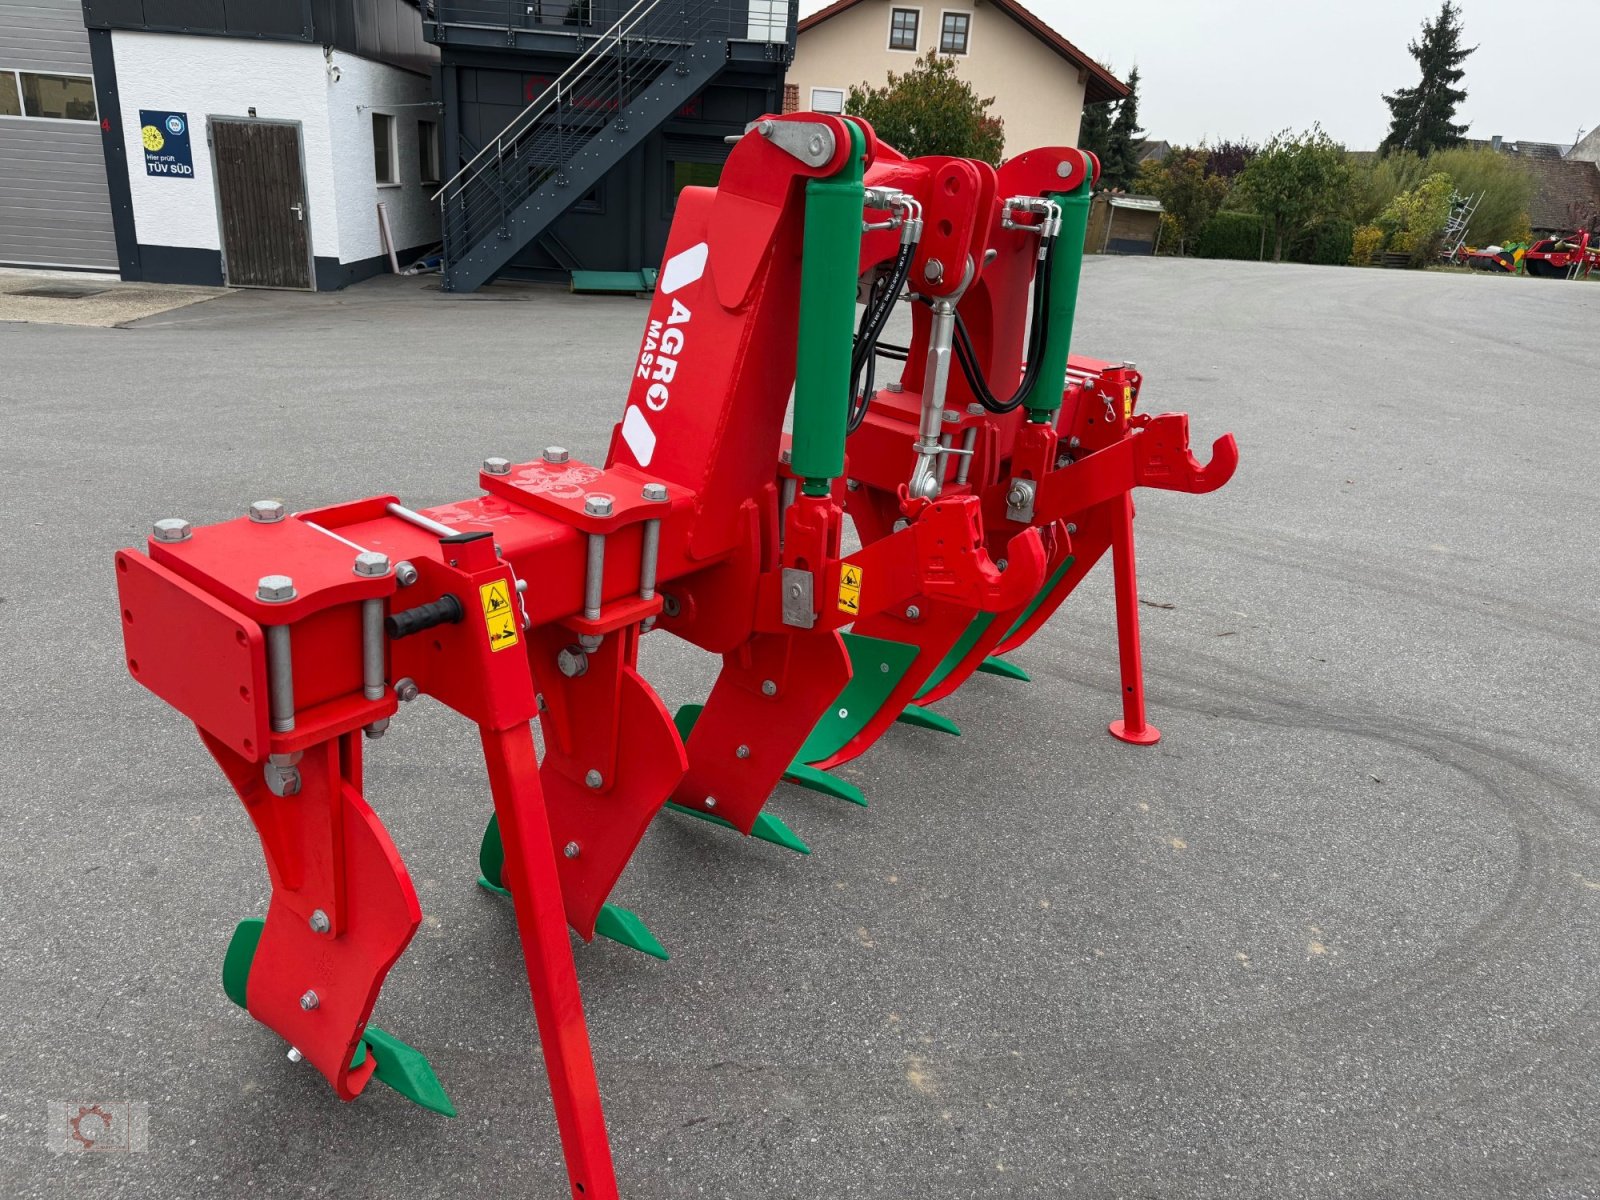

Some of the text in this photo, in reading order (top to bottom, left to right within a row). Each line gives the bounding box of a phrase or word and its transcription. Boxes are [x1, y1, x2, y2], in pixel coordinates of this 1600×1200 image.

[102, 118, 110, 132] 4
[148, 162, 191, 174] TÜV SÜD
[637, 319, 663, 379] MASZ
[645, 298, 691, 411] AGRO
